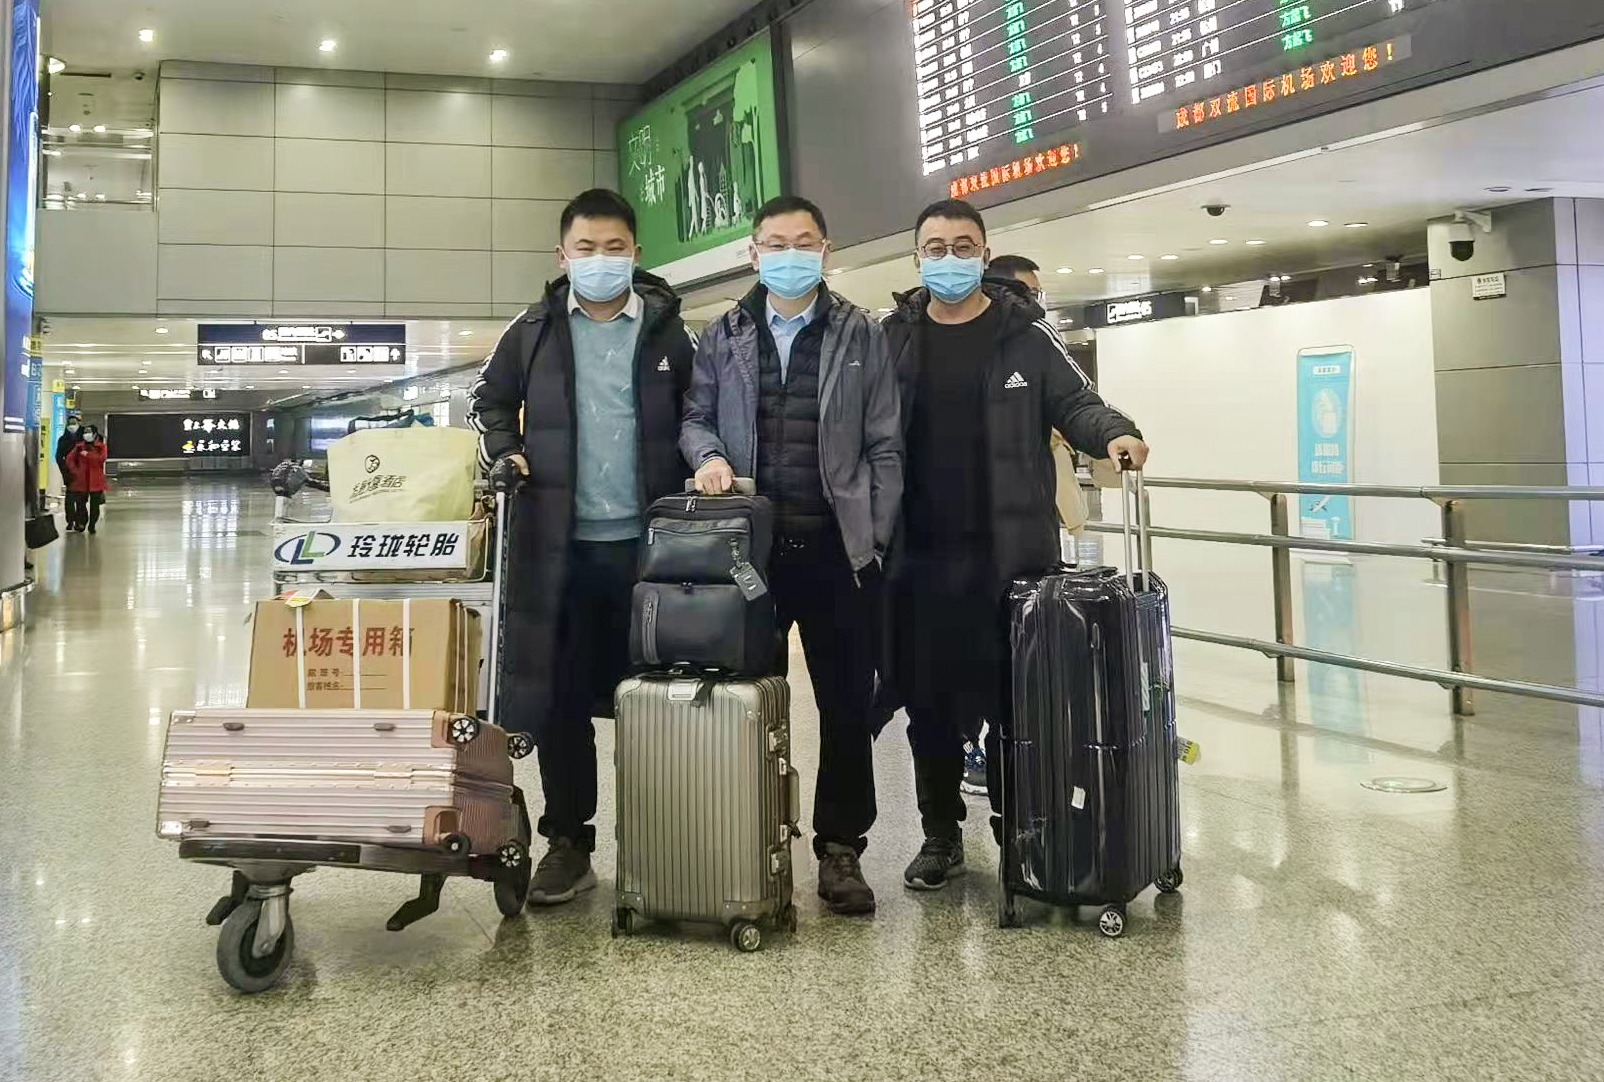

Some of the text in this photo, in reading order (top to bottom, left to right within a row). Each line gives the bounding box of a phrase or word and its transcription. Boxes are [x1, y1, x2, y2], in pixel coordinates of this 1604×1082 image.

[347, 533, 460, 558] 玲珑轮胎
[283, 626, 415, 658] 机场专用箱
